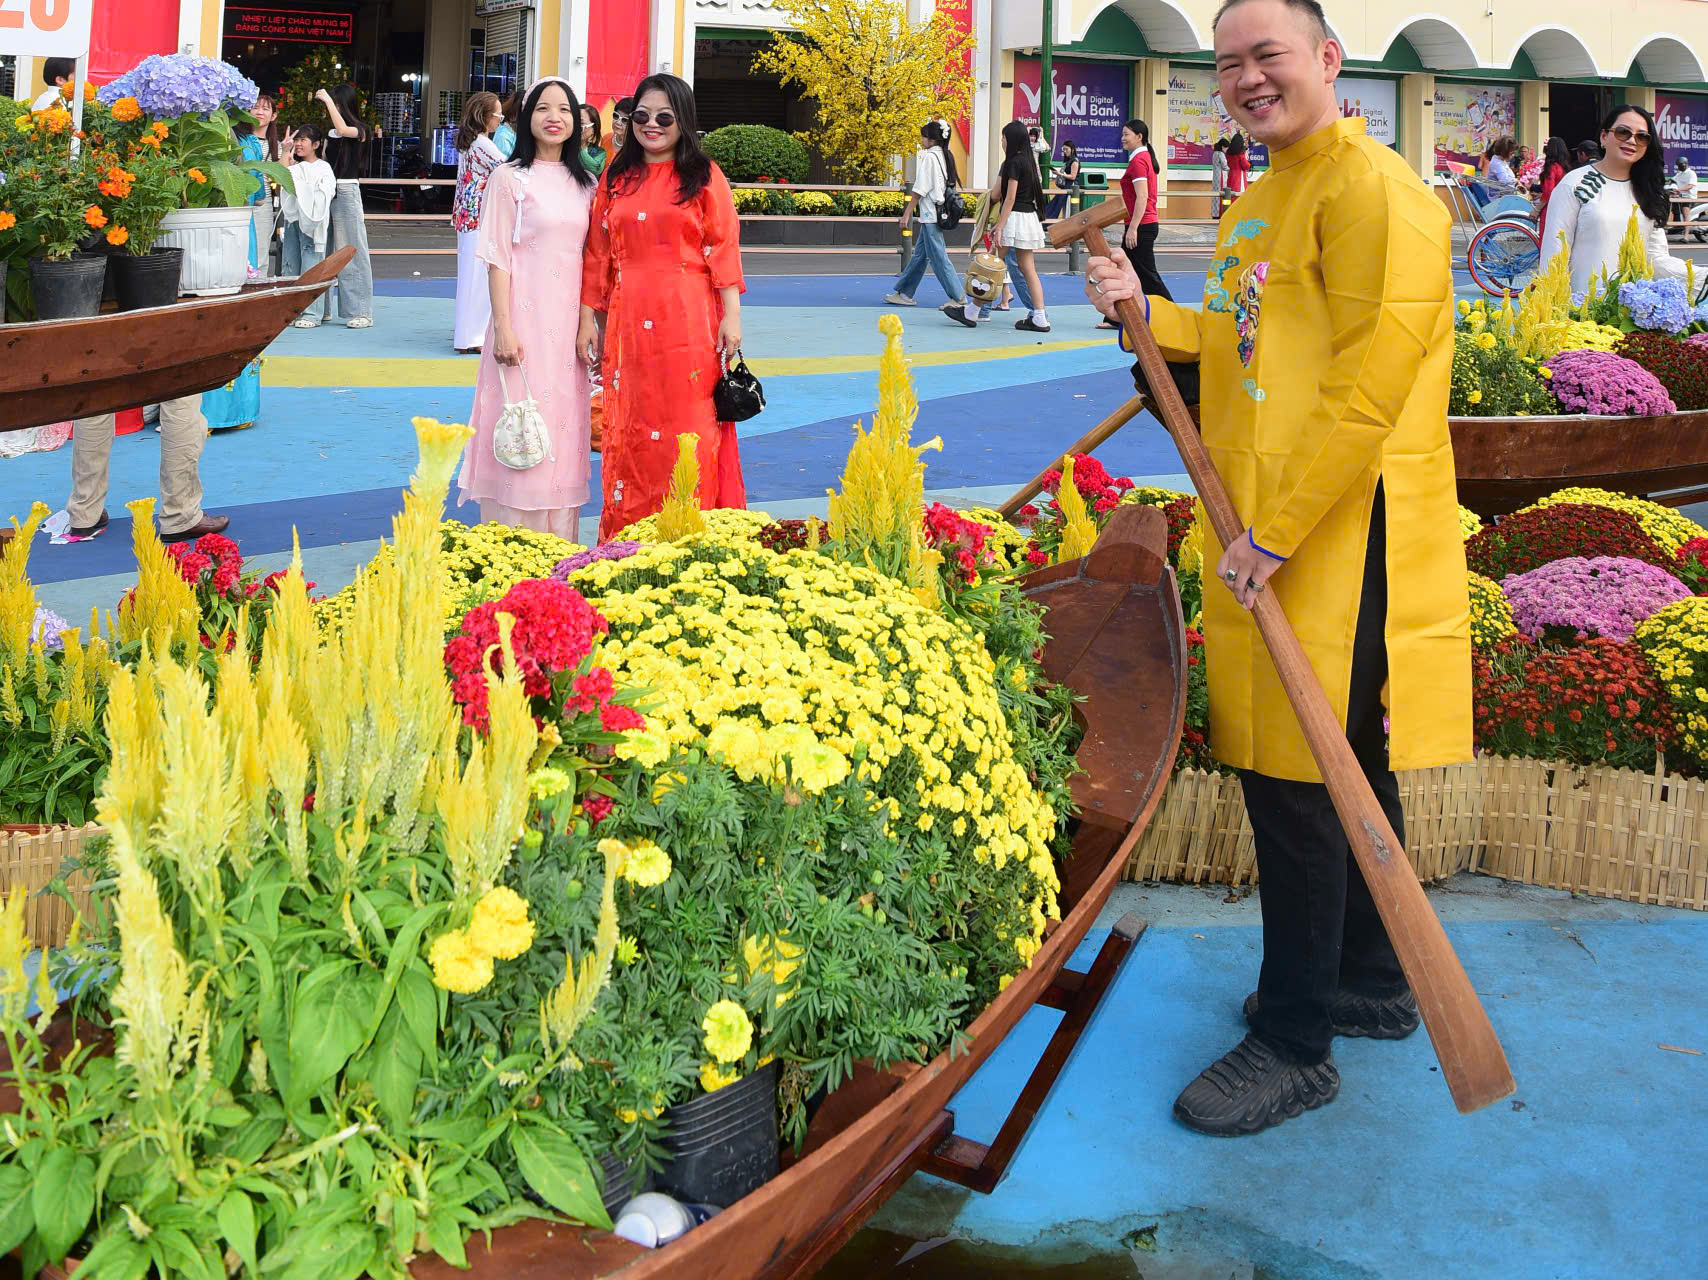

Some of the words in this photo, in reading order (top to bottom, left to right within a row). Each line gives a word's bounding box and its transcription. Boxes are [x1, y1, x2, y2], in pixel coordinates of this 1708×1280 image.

[326, 29, 344, 37] NAM
[1019, 70, 1087, 115] Vkki
[1090, 96, 1113, 105] Digital
[1090, 104, 1120, 116] Bank
